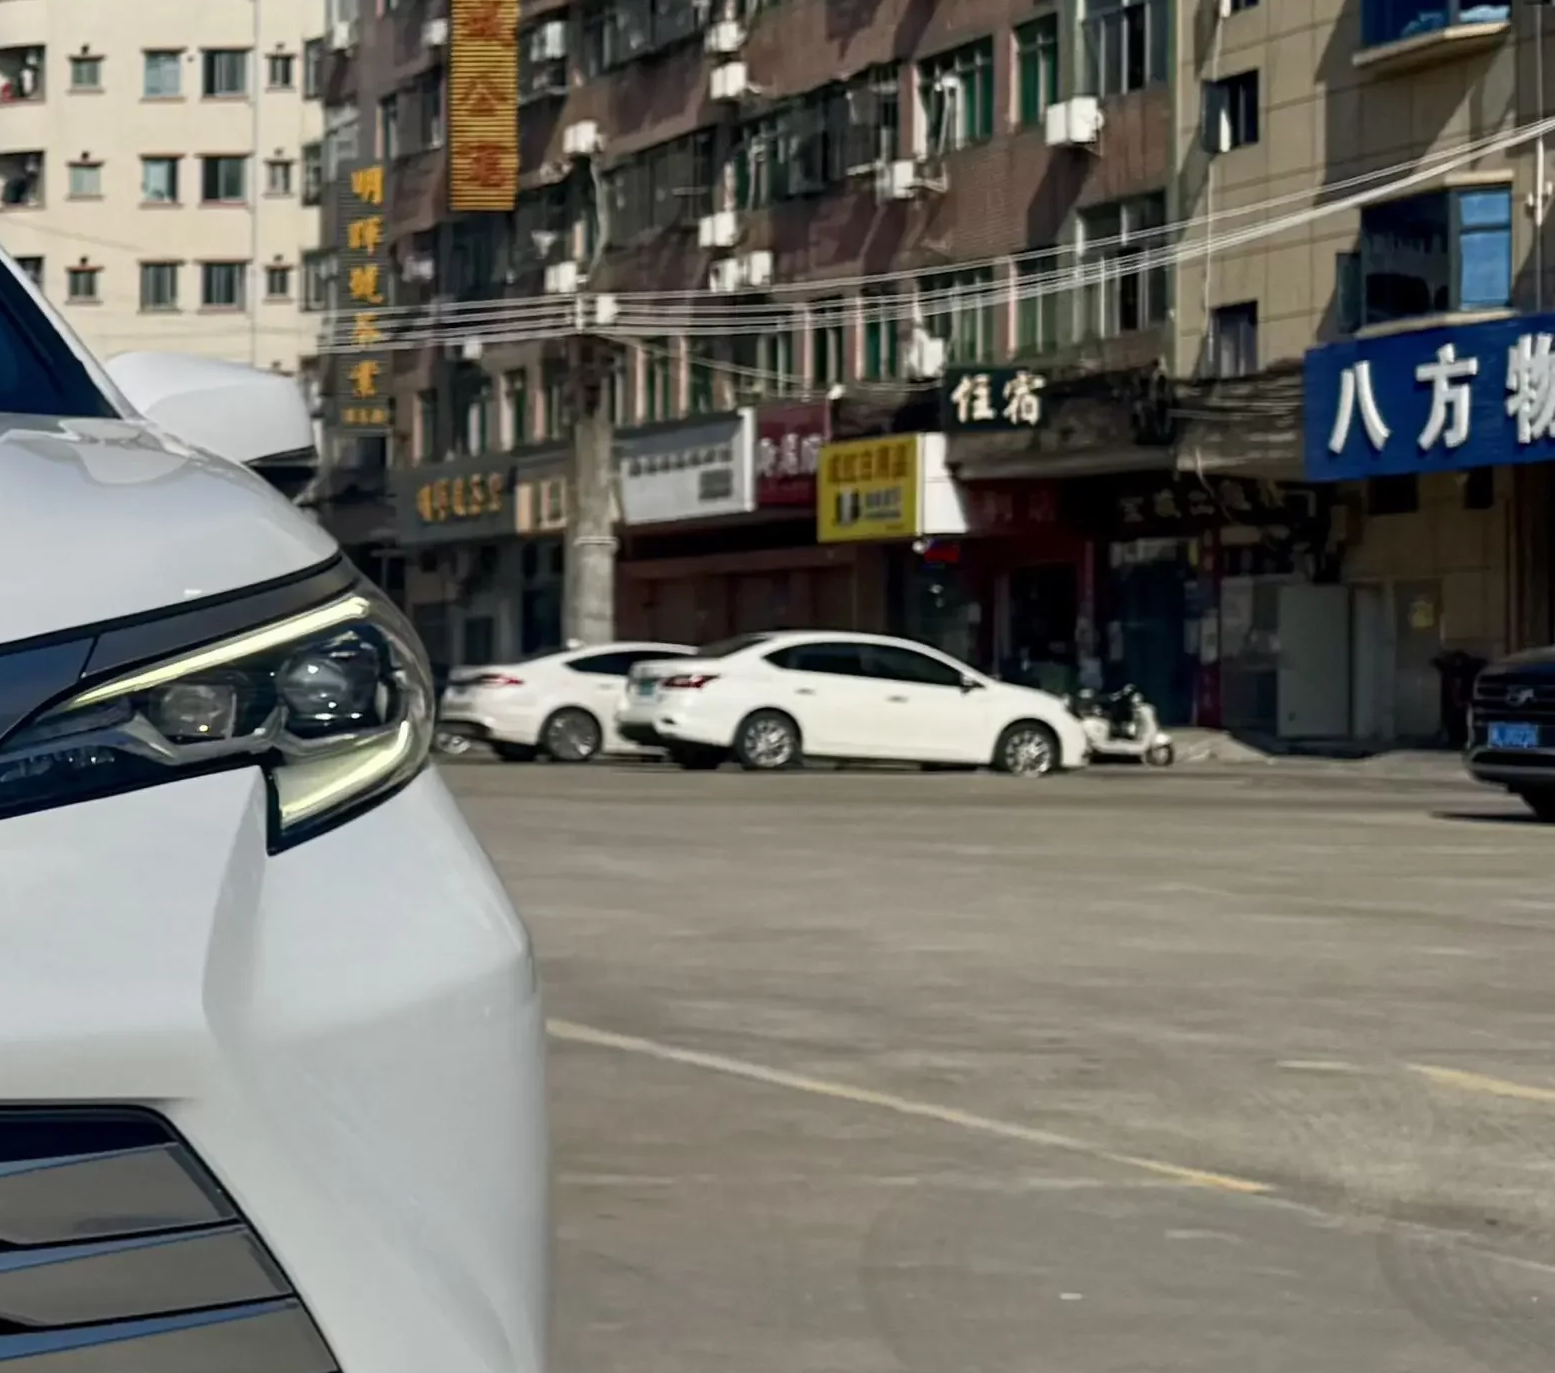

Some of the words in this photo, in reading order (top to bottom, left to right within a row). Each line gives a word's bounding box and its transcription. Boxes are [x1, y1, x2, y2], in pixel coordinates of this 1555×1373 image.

[950, 372, 1046, 425] 住宿
[1328, 332, 1555, 453] 八方物
